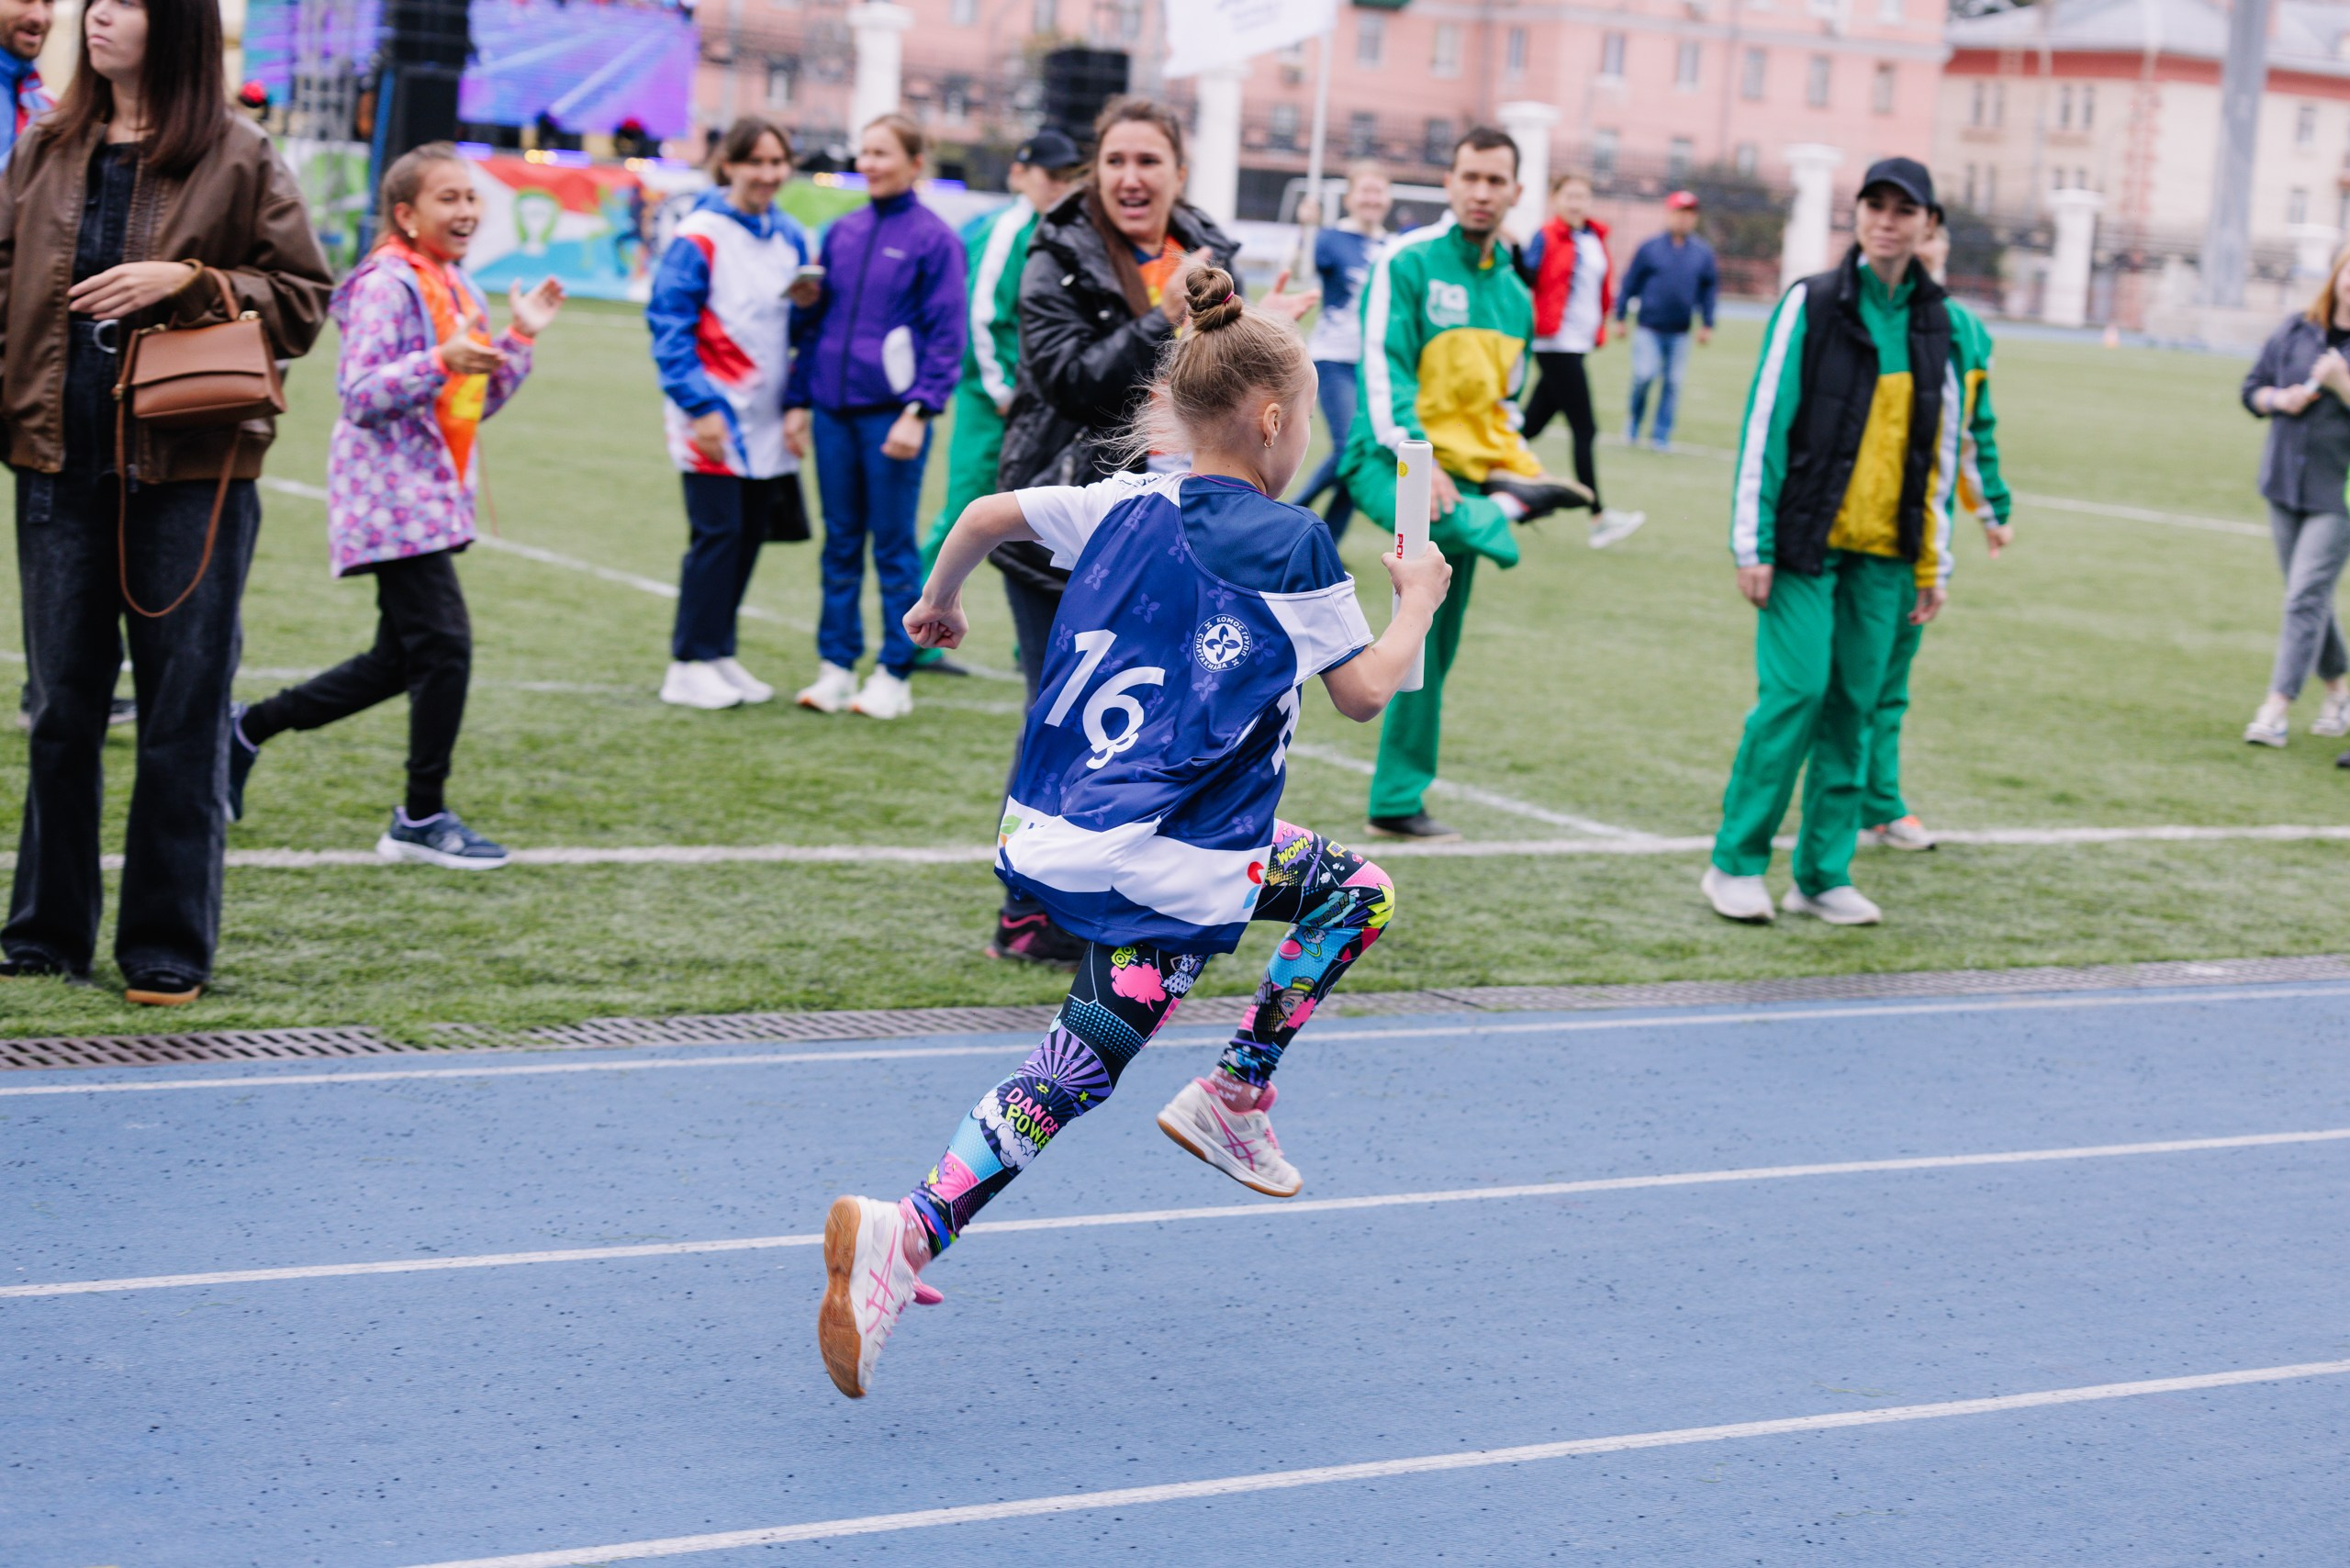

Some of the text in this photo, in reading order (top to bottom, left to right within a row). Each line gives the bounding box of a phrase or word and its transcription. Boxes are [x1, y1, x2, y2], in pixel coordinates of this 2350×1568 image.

[1195, 633, 1227, 670] СПАРТАКИАДА
[1216, 616, 1250, 656] КОМОС ГРУПП
[1045, 629, 1166, 769] 16
[1277, 836, 1310, 866] WOW!
[1005, 1087, 1058, 1137] DANCE
[1005, 1103, 1050, 1150] POWE
